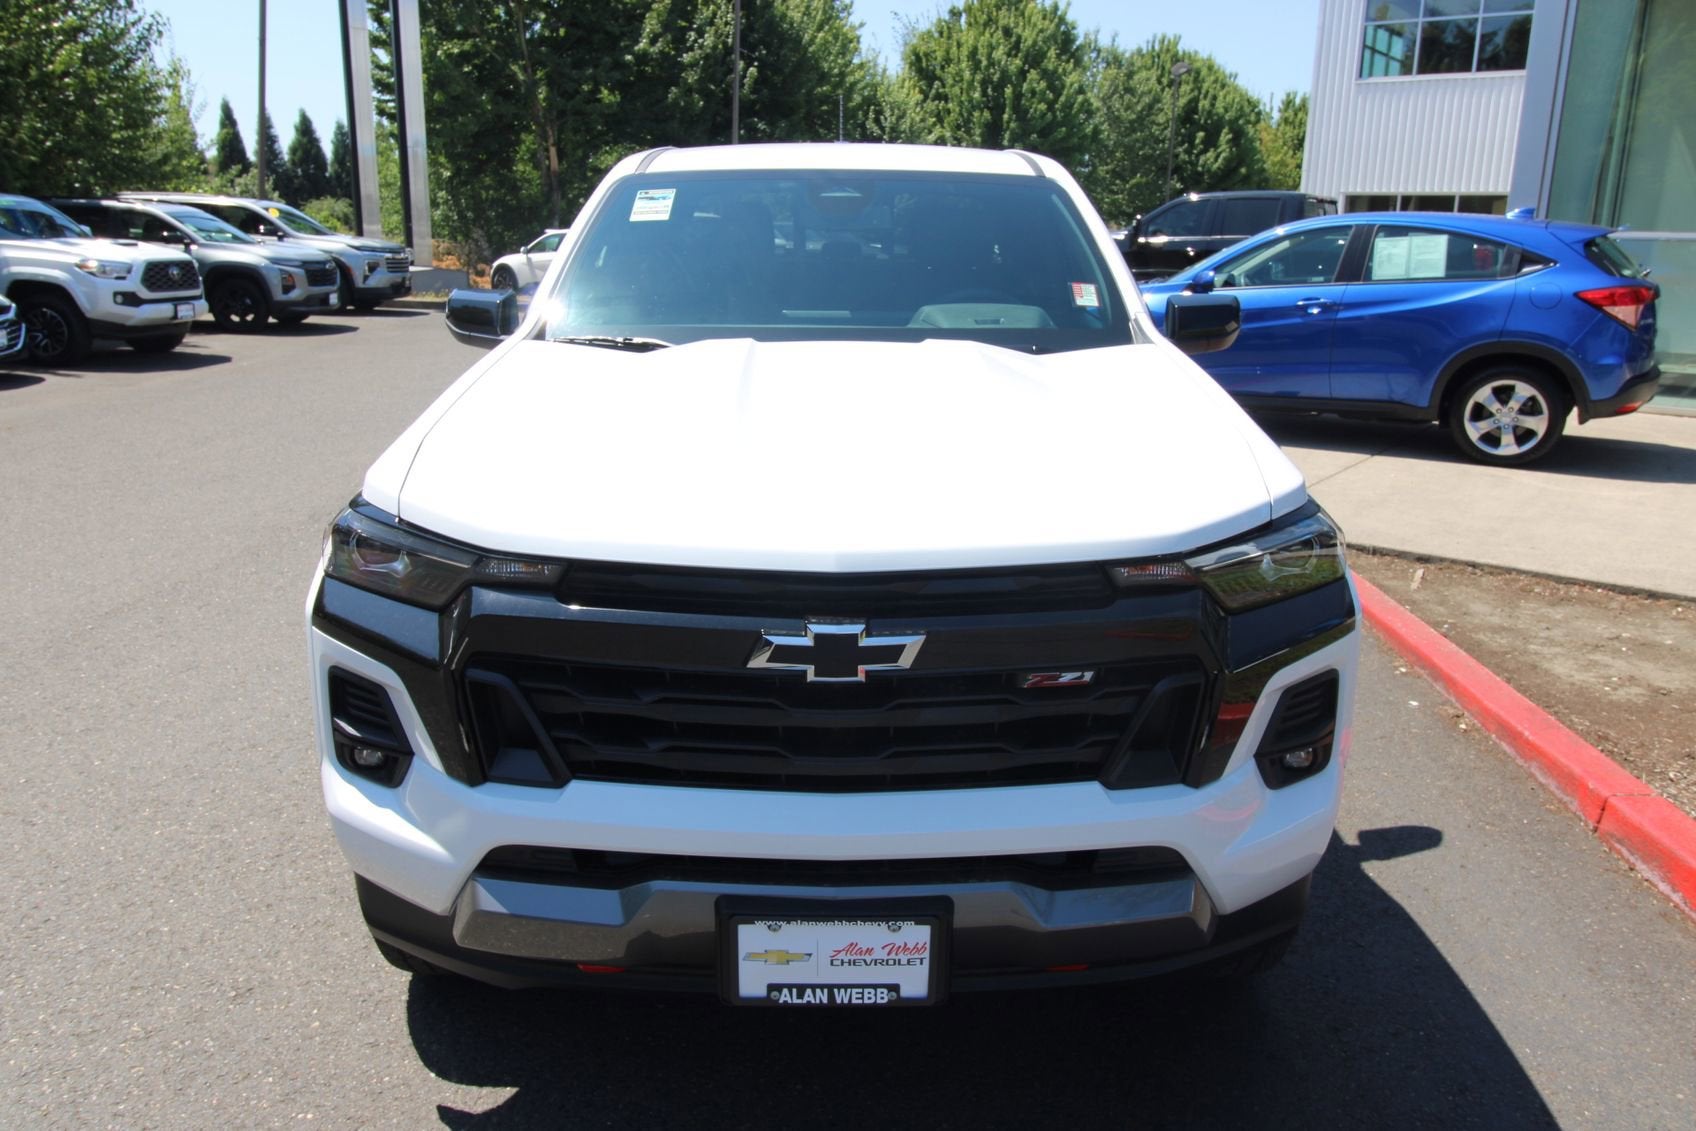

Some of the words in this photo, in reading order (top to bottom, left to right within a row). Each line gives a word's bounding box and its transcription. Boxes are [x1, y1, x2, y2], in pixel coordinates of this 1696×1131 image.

[829, 942, 874, 958] Alan
[881, 941, 928, 957] Webb
[829, 957, 927, 967] CHEVROLET
[778, 988, 829, 1004] ALAN
[834, 988, 889, 1004] WEBB
